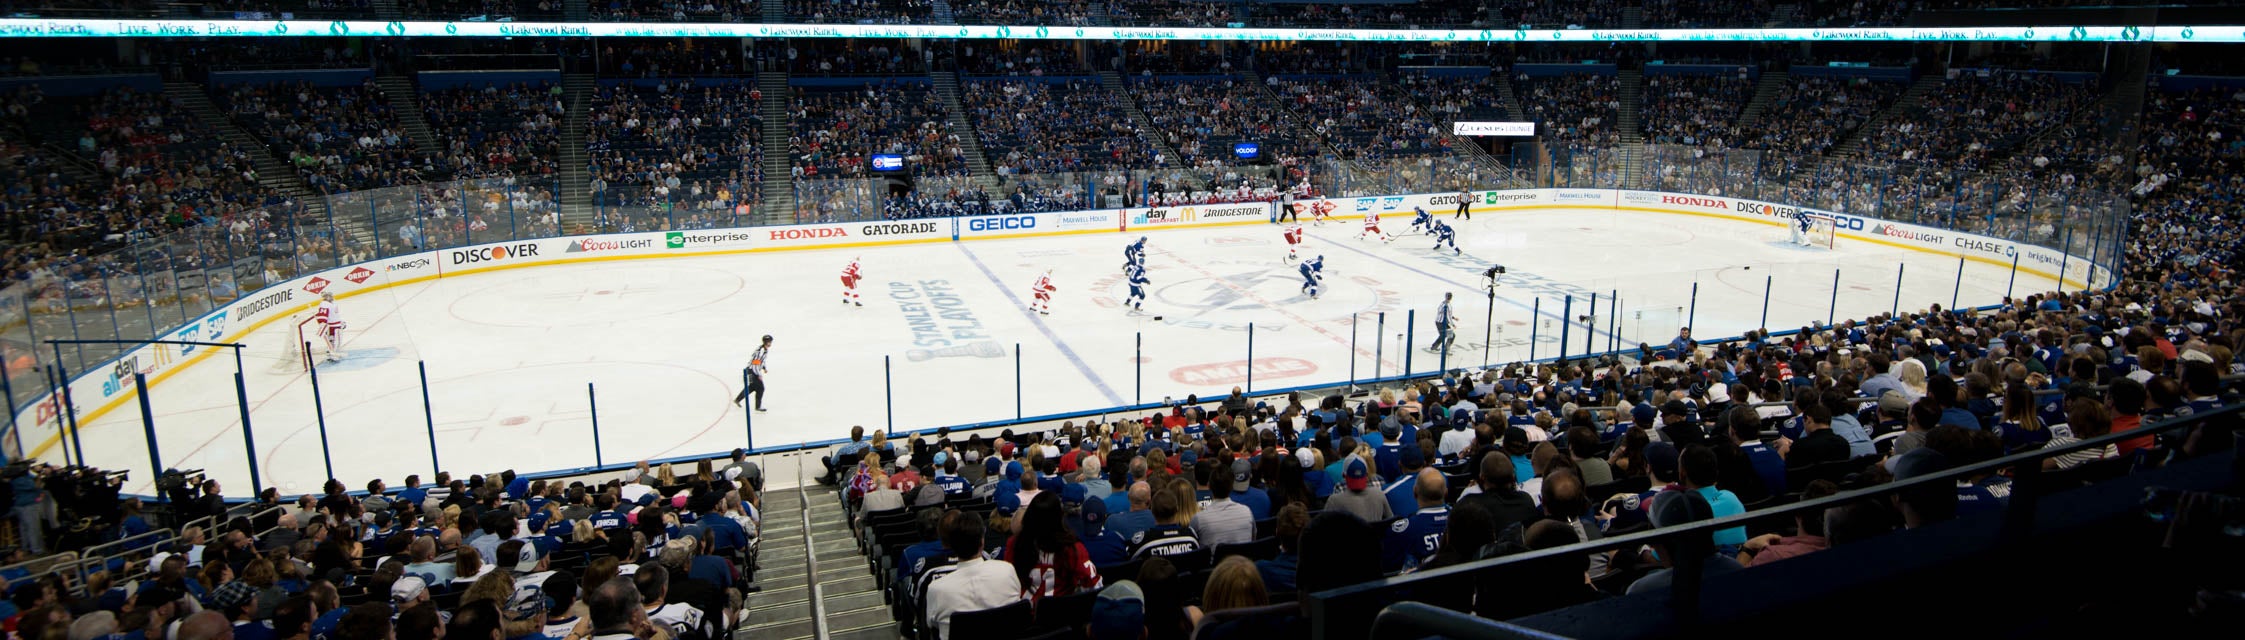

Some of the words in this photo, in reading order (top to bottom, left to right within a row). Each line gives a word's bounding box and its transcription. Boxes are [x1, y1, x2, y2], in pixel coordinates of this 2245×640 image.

[118, 23, 152, 35] LIVE.
[157, 23, 200, 35] WORK.
[208, 23, 241, 35] PLAY.
[1661, 196, 1728, 209] HONDA
[1133, 214, 1148, 225] all
[1147, 208, 1167, 219] day
[1203, 207, 1262, 218] BRIDGESTONE
[862, 223, 937, 236] GATORADE
[969, 216, 1036, 231] GEICO
[671, 232, 749, 245] enterprise
[770, 227, 848, 240] HONDA
[1884, 224, 1914, 239] Coors
[1915, 233, 1944, 245] LIGHT
[581, 238, 619, 252] Coors
[620, 239, 652, 249] LIGHT
[453, 243, 538, 265] DISCOVER
[396, 259, 430, 270] NBCSN
[347, 270, 371, 282] ORKIN
[888, 281, 921, 300] CUP
[918, 279, 992, 339] PLAYOFFS
[898, 300, 953, 347] STANLEY
[595, 518, 619, 528] JOHNSON
[1151, 542, 1193, 556] STAMKOS
